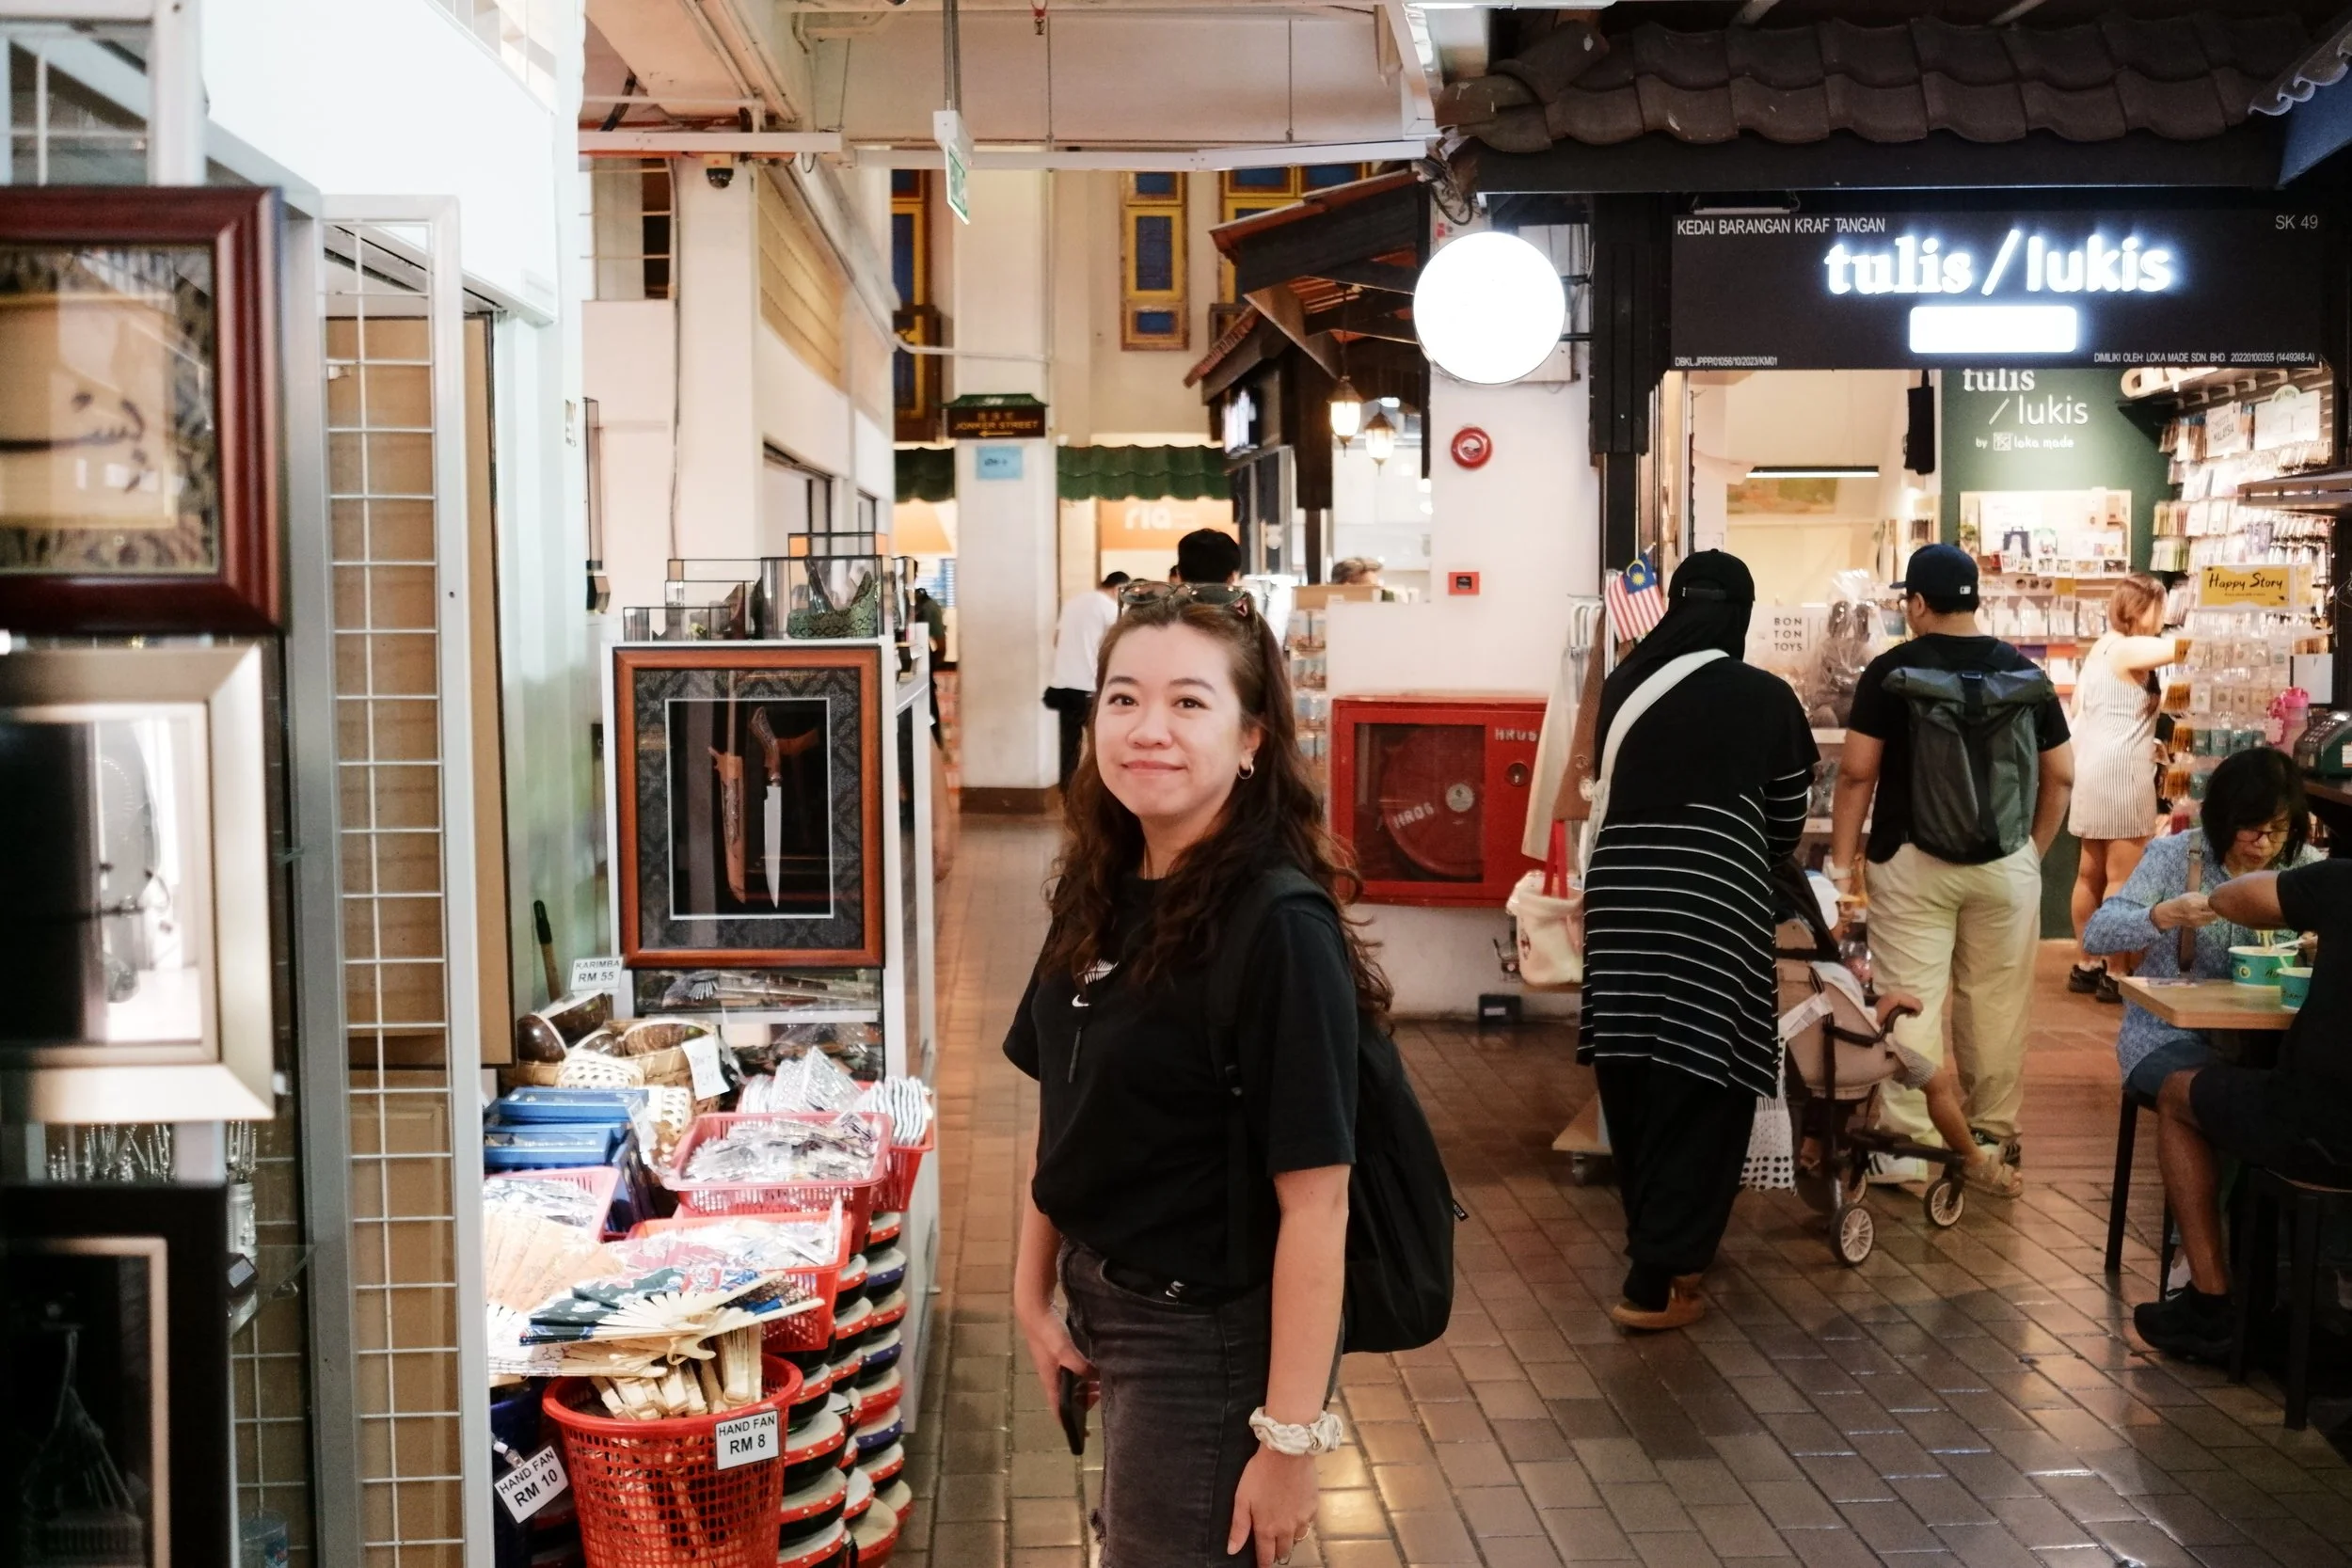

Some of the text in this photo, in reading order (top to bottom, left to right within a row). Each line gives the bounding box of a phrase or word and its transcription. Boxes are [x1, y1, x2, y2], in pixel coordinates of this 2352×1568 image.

[1677, 217, 1885, 235] KEDAI BARANGAN KRAF TANGAN
[2275, 214, 2318, 230] SK 49
[1824, 235, 1973, 294] tulis
[2026, 234, 2171, 293] lukis
[2094, 352, 2121, 363] DIMILIKI
[2146, 352, 2166, 363] LOKA
[2168, 352, 2188, 363] MADE
[2190, 352, 2207, 363] SDN.
[2210, 352, 2226, 363] BHD.
[2019, 394, 2089, 424] lukis
[1976, 434, 2074, 450] by loka made
[2209, 572, 2282, 591] Happy Story
[1774, 617, 1802, 626] BON
[1774, 630, 1802, 639] TON
[576, 959, 620, 970] KARIMBA
[579, 972, 613, 982] RM 55
[719, 1415, 774, 1436] HAND FAN
[730, 1433, 766, 1455] RM 8
[499, 1450, 554, 1494] HAND FAN
[514, 1469, 558, 1507] RM 10
